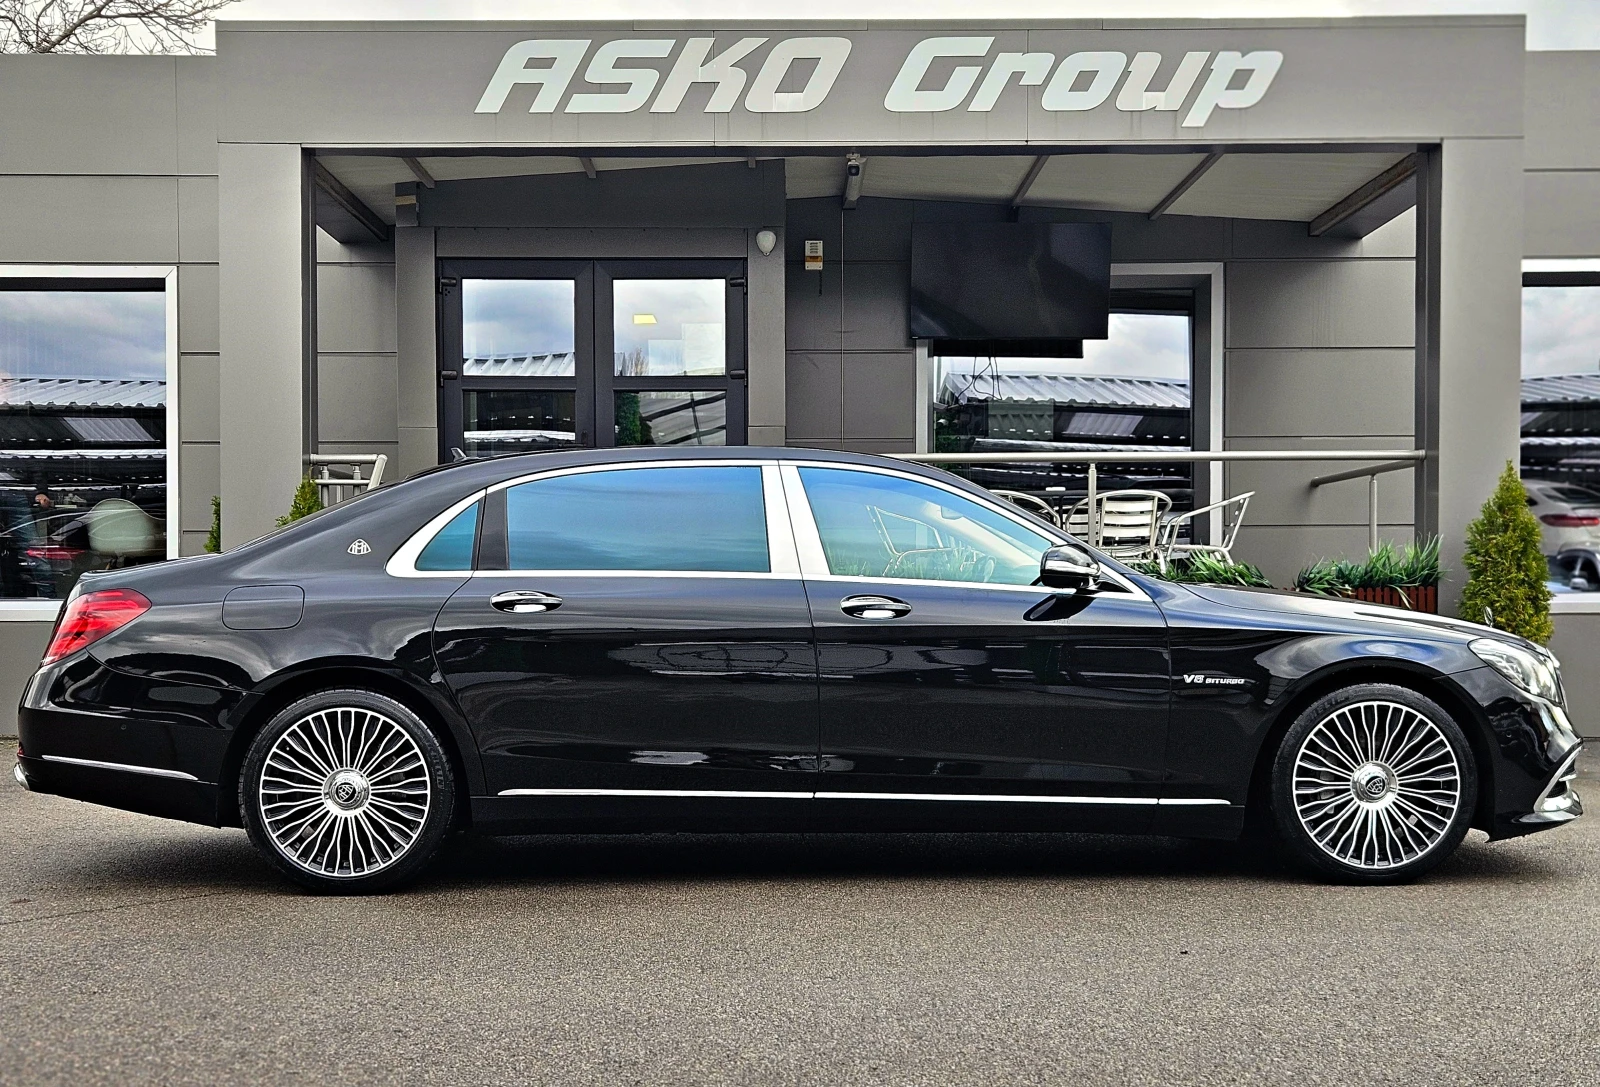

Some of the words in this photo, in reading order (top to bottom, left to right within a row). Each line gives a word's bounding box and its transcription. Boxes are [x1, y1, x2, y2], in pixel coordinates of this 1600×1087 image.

[474, 36, 852, 114] ASKO
[884, 36, 1283, 127] Group
[1183, 674, 1205, 684] V8
[1205, 677, 1245, 685] BITURBO
